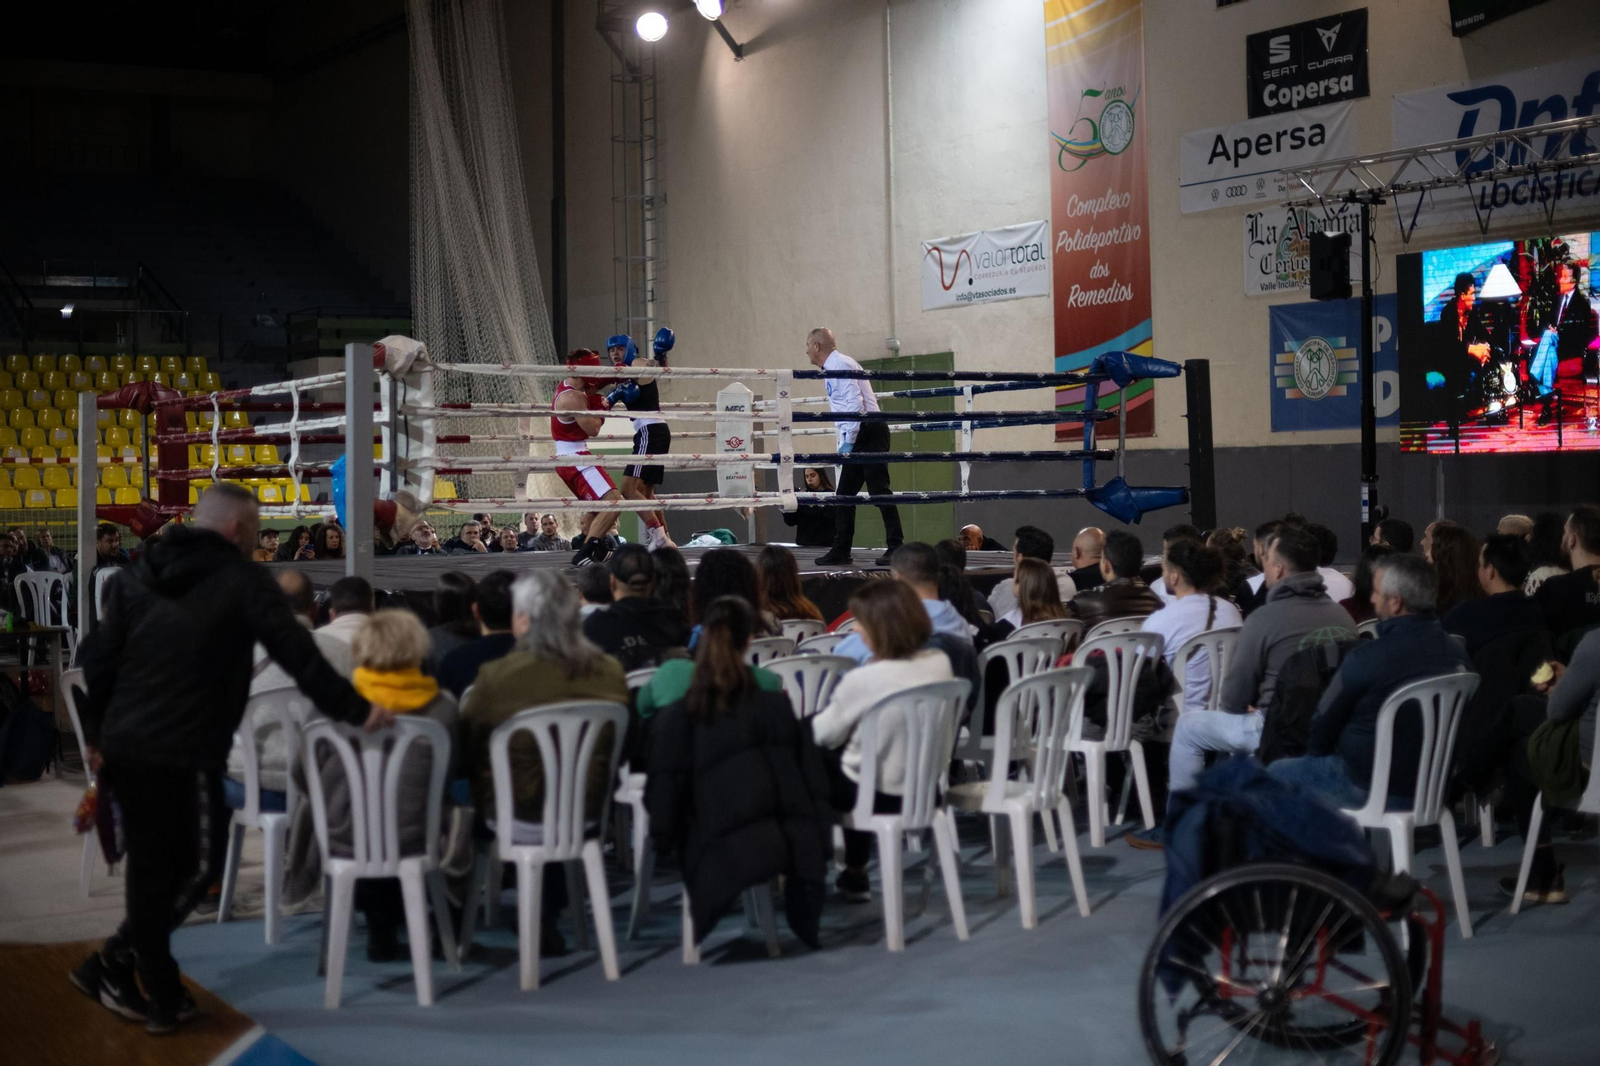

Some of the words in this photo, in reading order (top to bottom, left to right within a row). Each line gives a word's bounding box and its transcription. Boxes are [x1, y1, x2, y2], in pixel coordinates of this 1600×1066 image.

[1455, 13, 1485, 28] MONDO
[1263, 65, 1298, 80] SEAT
[1307, 54, 1353, 70] CUPRA
[1263, 74, 1354, 109] Copersa
[1207, 122, 1326, 168] Apersa
[1066, 187, 1131, 219] Complexo
[1055, 222, 1141, 254] Polideportivo
[1246, 212, 1277, 259] La
[1089, 259, 1110, 279] dos
[956, 287, 1016, 302] info@vtasociados.es
[1067, 279, 1134, 308] Remedios
[1260, 281, 1277, 291] Valle
